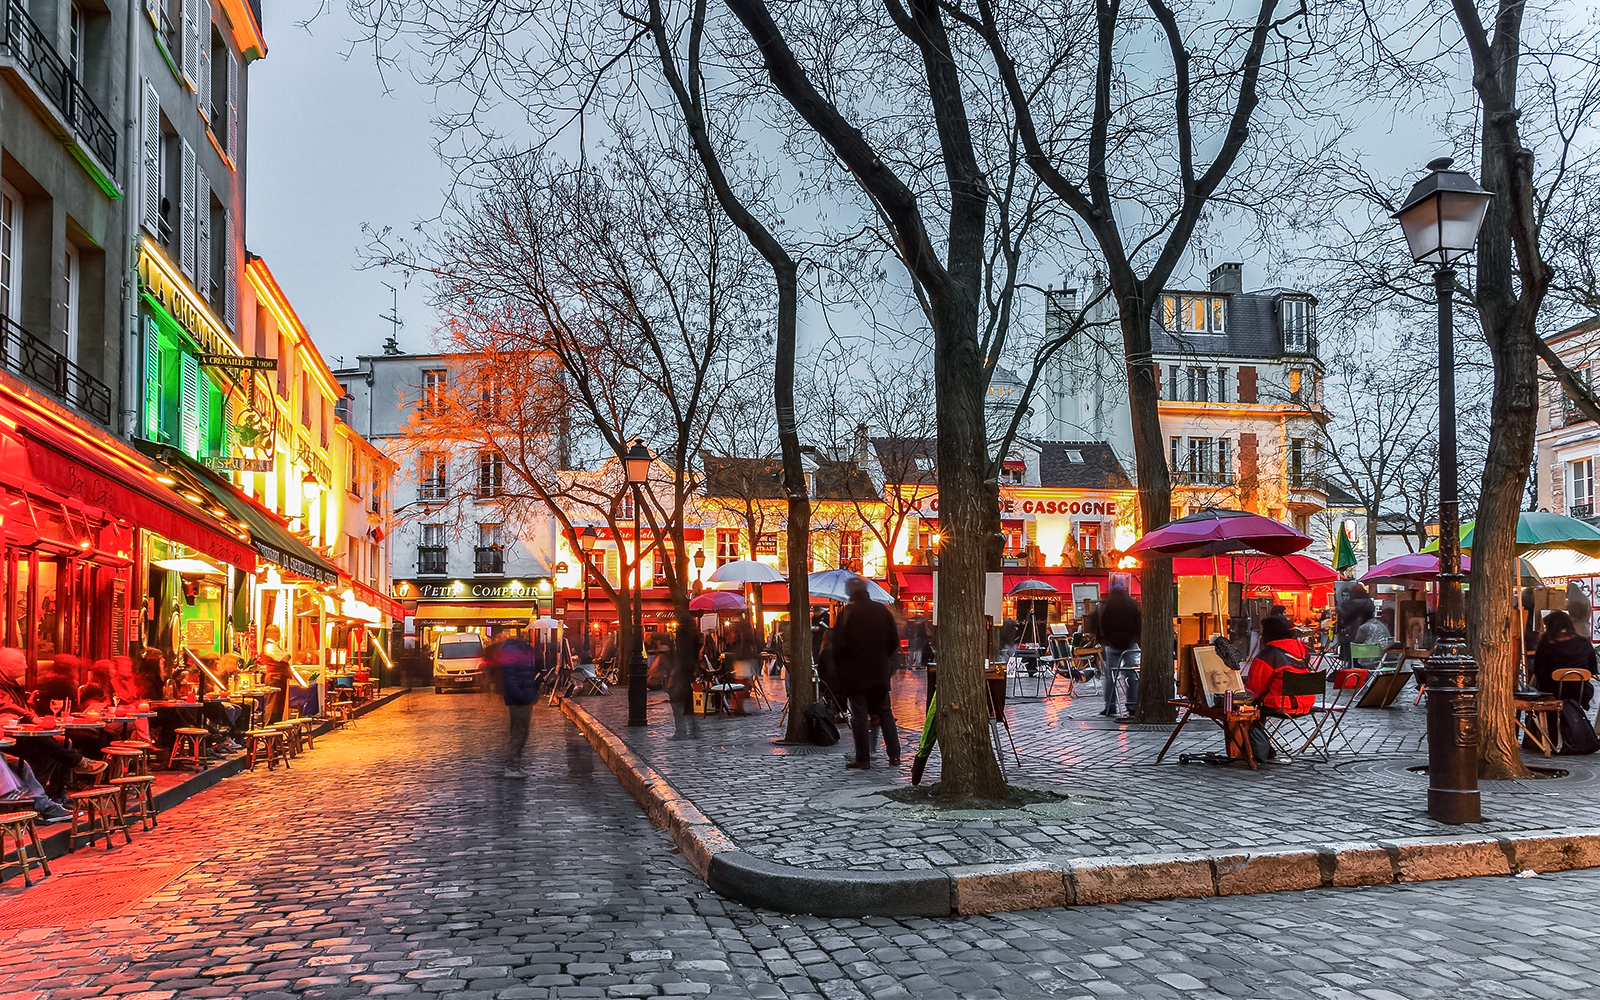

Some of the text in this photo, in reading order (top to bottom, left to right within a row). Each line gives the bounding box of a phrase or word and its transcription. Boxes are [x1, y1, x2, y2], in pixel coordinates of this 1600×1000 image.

[143, 256, 168, 307] LA
[1022, 500, 1116, 516] GASCOGNE
[420, 584, 460, 597] PETIT
[472, 584, 539, 597] COMPTOIR
